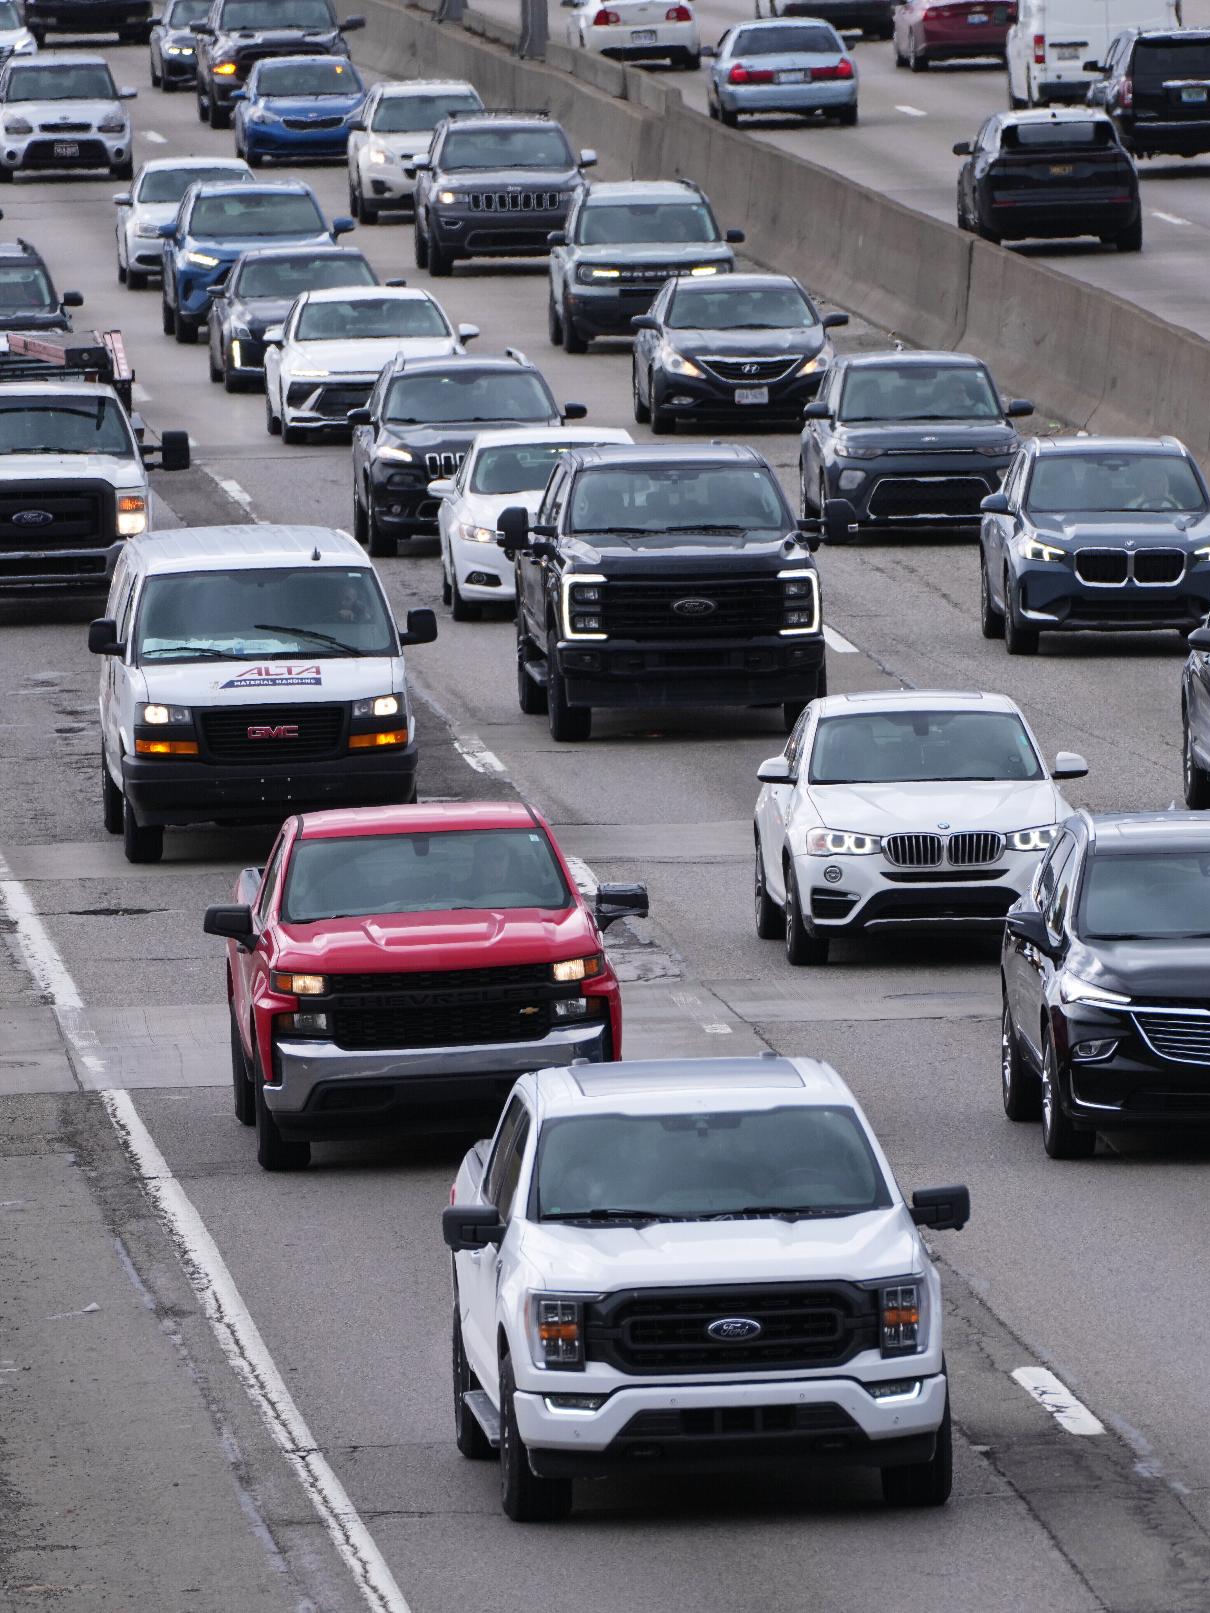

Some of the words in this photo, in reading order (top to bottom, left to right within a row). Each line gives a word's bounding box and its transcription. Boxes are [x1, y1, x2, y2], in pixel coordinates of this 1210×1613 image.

[236, 666, 321, 677] ALTA
[248, 726, 298, 739] GMC
[337, 987, 541, 1008] CHEVROLET
